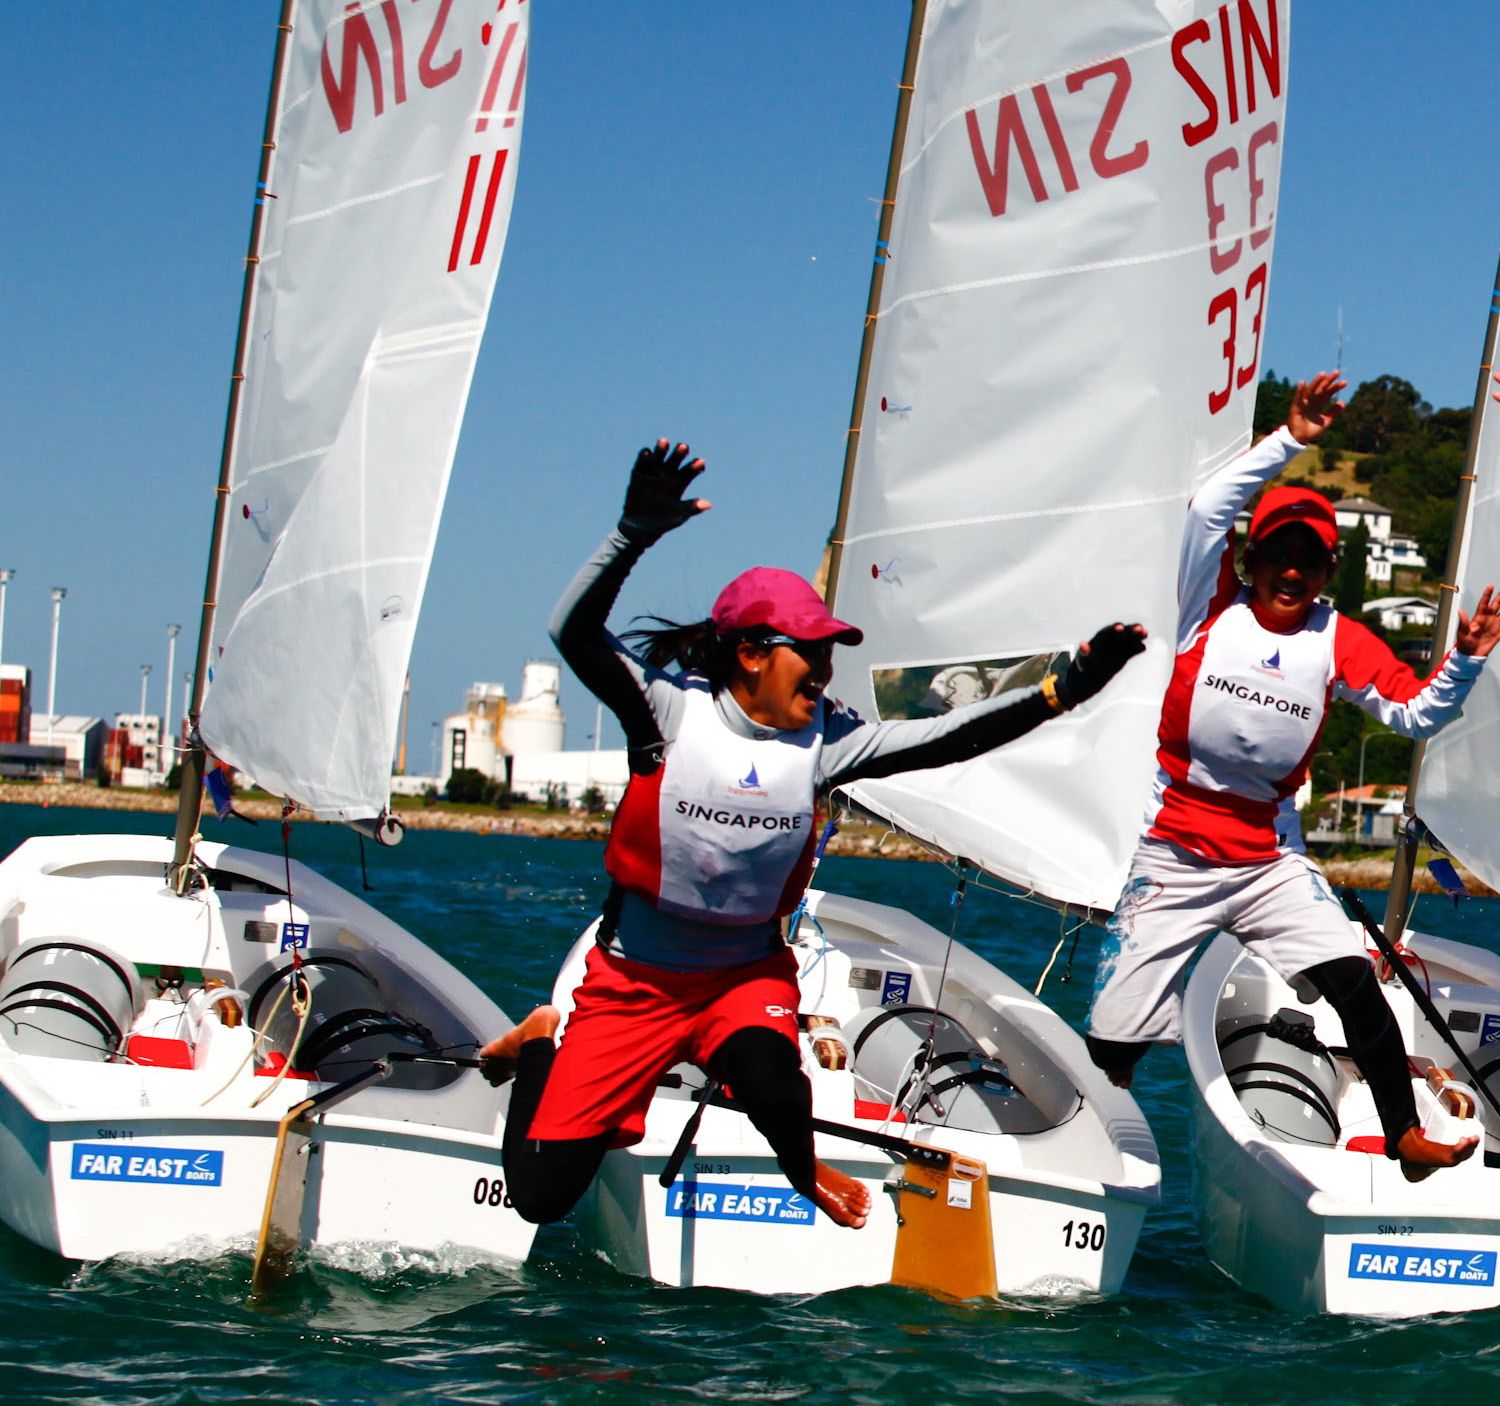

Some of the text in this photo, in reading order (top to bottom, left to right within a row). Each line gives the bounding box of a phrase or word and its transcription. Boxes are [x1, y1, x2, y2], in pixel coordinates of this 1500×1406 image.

[1171, 0, 1281, 147] SIN
[447, 149, 509, 273] 11
[1207, 262, 1267, 415] 33
[1204, 675, 1312, 720] SINGAPORE
[675, 800, 802, 830] SINGAPORE
[97, 1129, 134, 1140] SIN 11
[79, 1154, 188, 1179] FAR EAST
[185, 1171, 216, 1181] BOATS
[693, 1163, 731, 1174] SIN 33
[673, 1191, 783, 1216] FAR EAST
[779, 1209, 809, 1219] BOATS
[1062, 1220, 1105, 1251] 130
[1377, 1224, 1414, 1236] SIN 22
[1356, 1253, 1462, 1279] FAR EAST
[1459, 1271, 1489, 1281] BOATS
